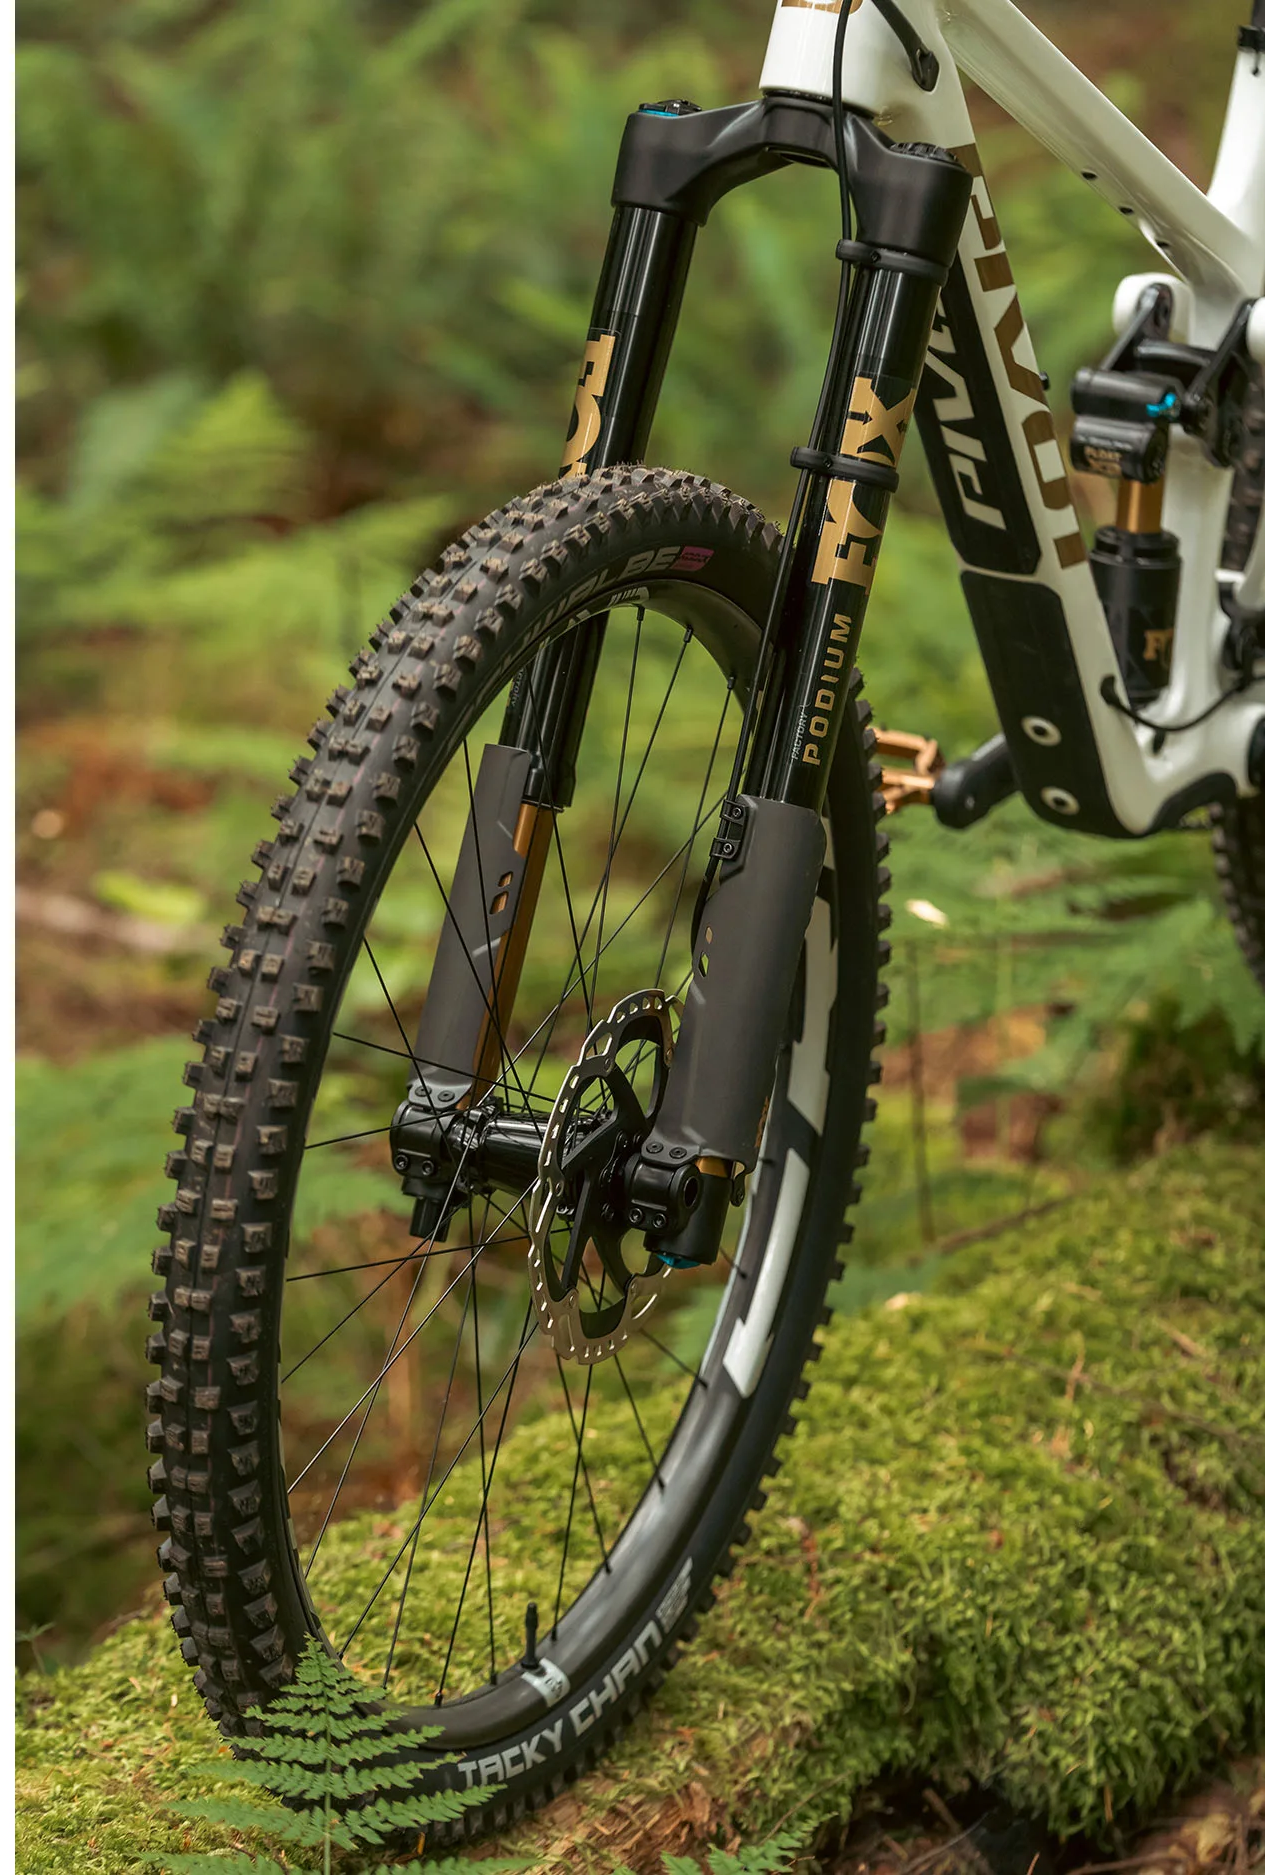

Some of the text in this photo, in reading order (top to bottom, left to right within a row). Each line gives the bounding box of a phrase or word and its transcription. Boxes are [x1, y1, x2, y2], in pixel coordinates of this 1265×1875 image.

[791, 711, 810, 760] FACTORY
[802, 613, 853, 767] PODIUM
[457, 1619, 663, 1788] TACKY CHAN
